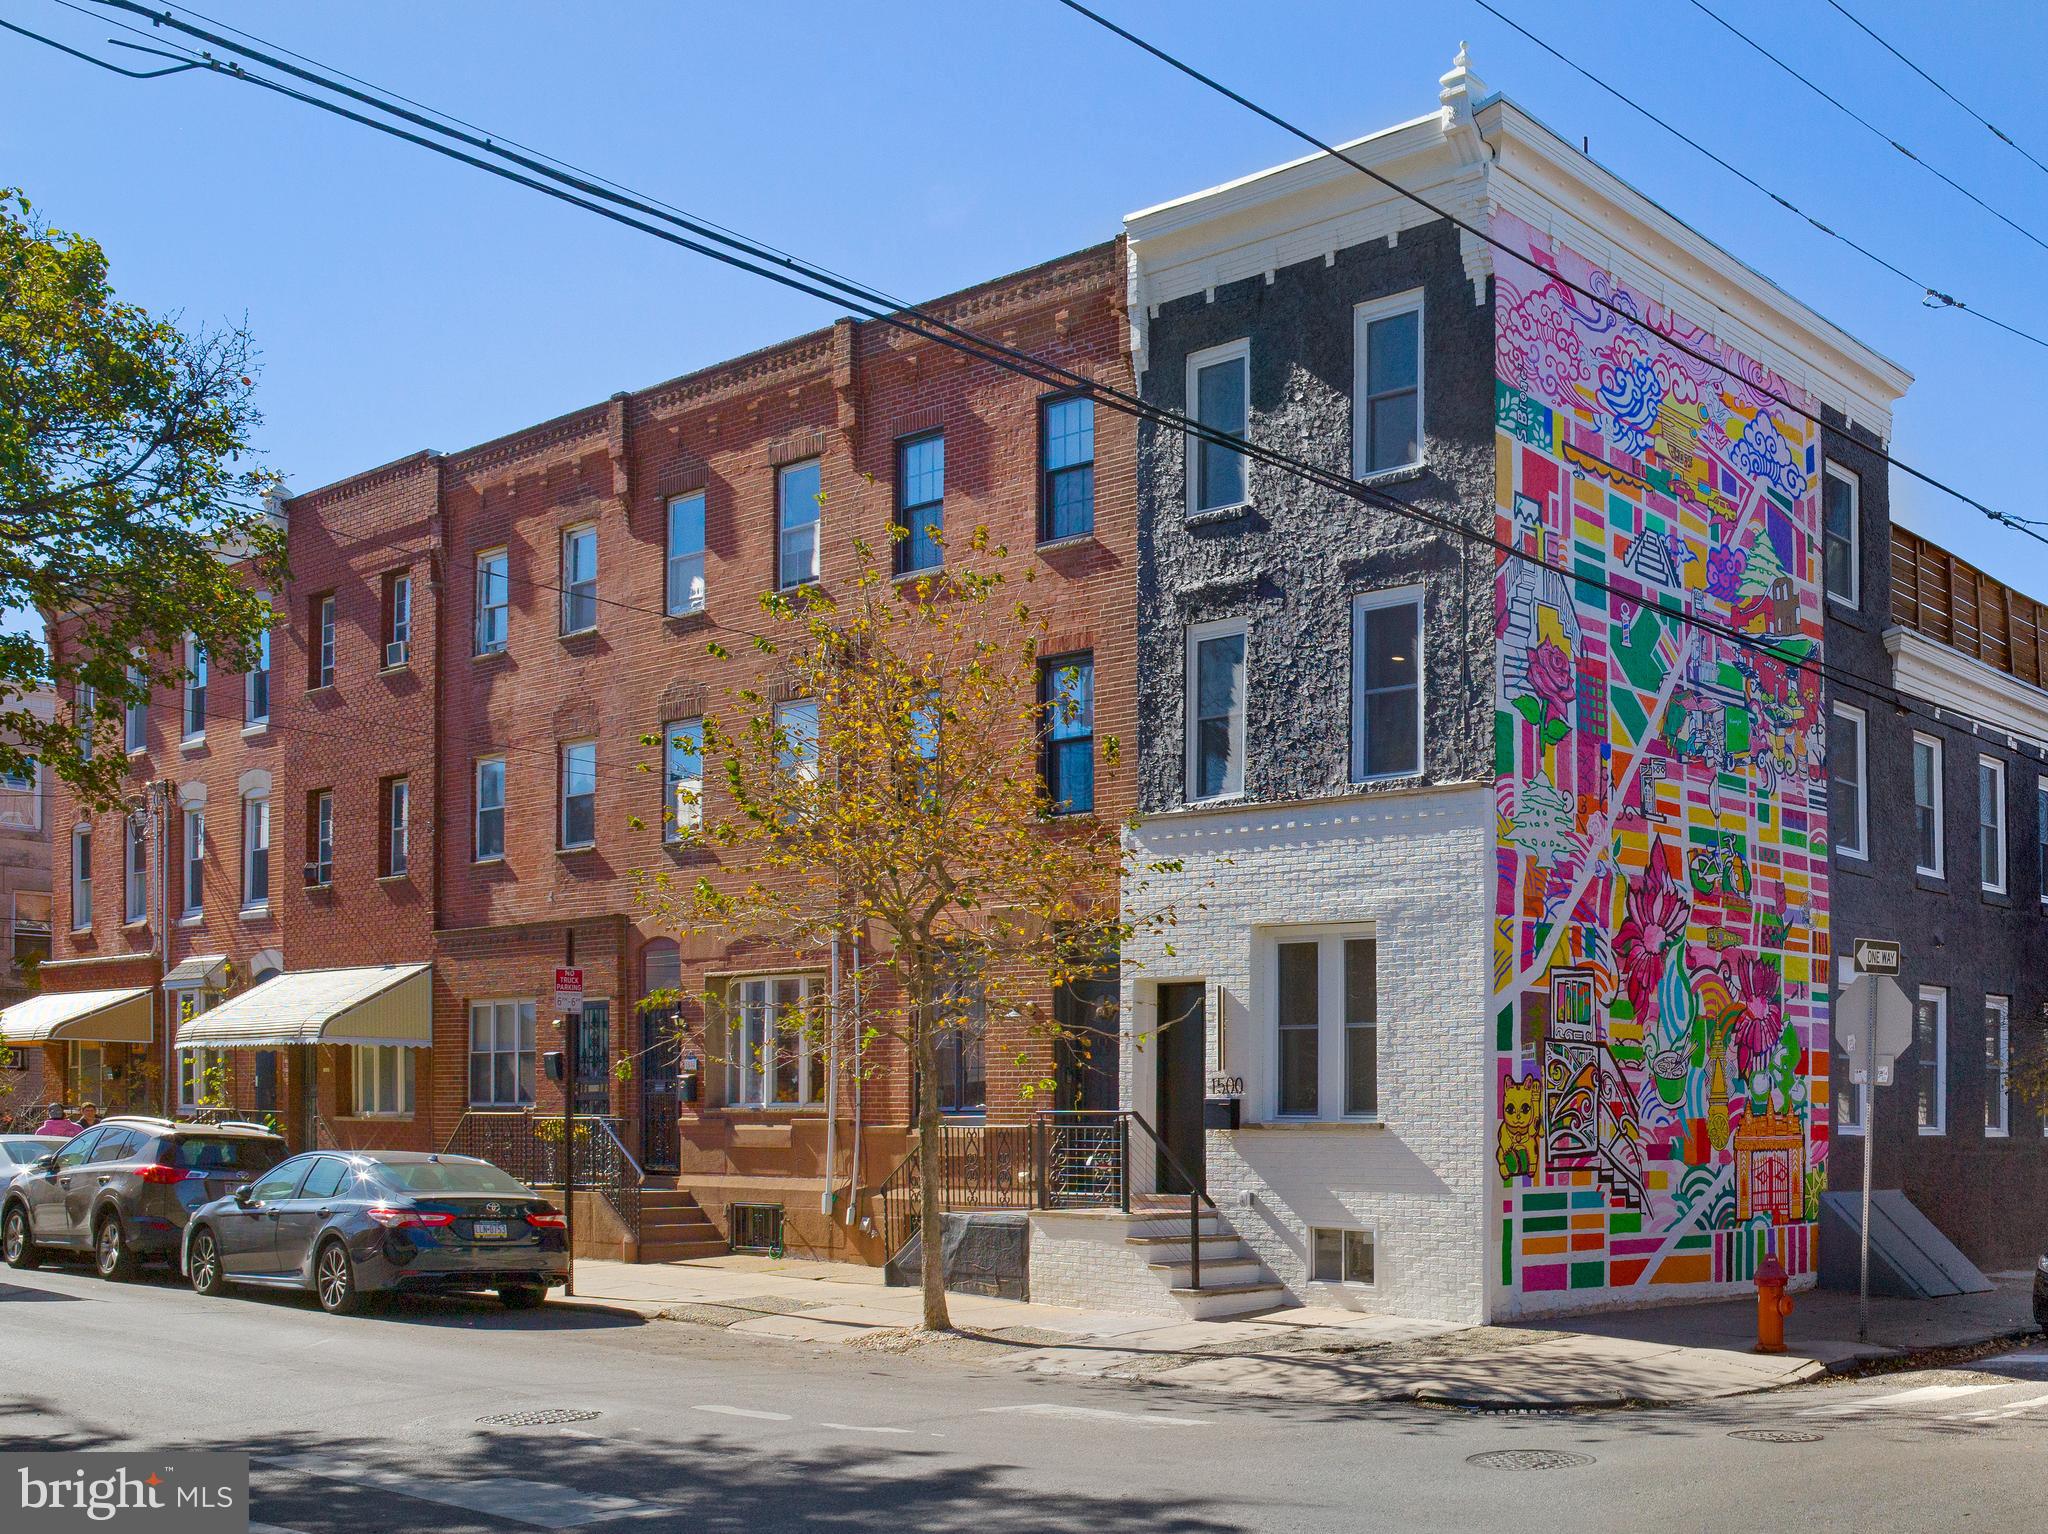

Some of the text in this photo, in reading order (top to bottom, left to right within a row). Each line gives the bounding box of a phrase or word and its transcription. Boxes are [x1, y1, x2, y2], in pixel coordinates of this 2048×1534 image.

[1867, 950, 1896, 965] ONE WAY
[1212, 1077, 1244, 1095] 1500
